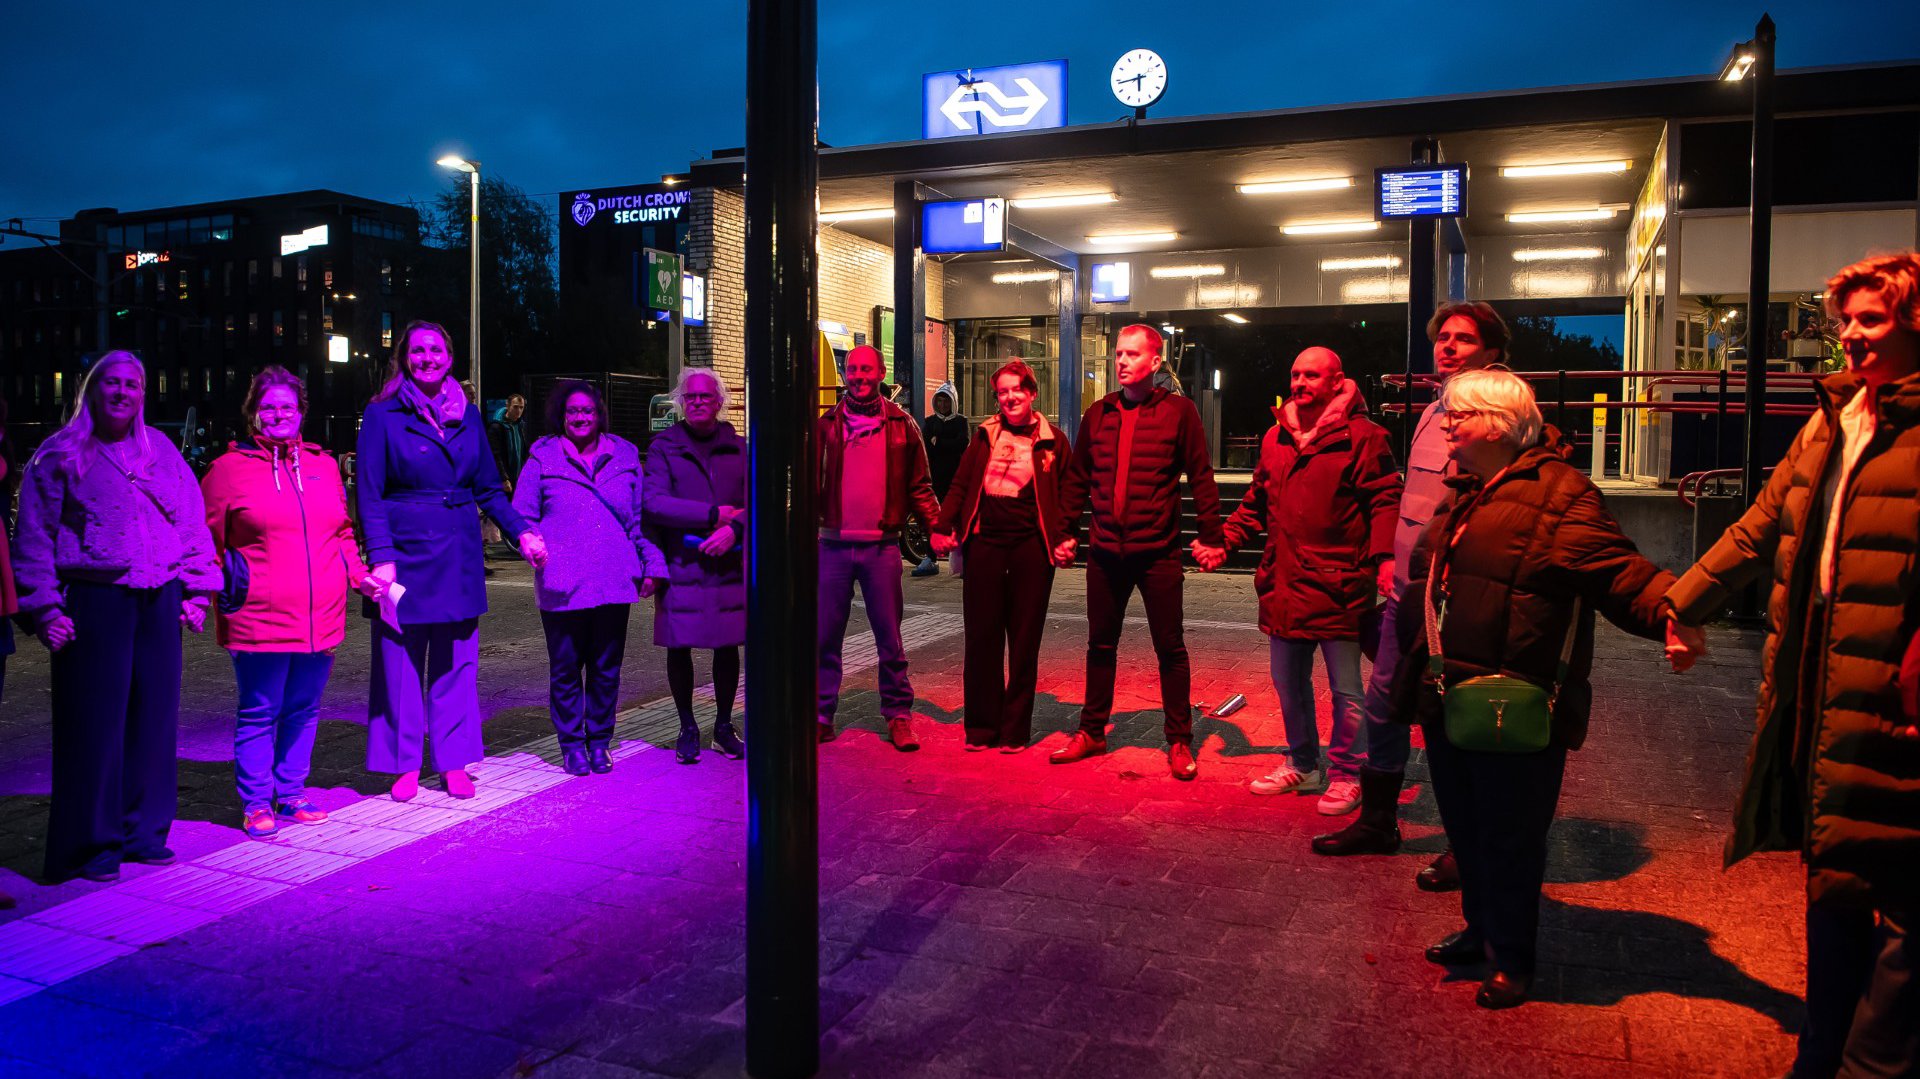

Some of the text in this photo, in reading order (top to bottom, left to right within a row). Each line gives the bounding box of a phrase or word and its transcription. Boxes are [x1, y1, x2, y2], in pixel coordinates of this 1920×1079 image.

[598, 191, 690, 210] DUTCH CROW
[614, 206, 681, 223] SECURITY
[656, 294, 673, 305] AED
